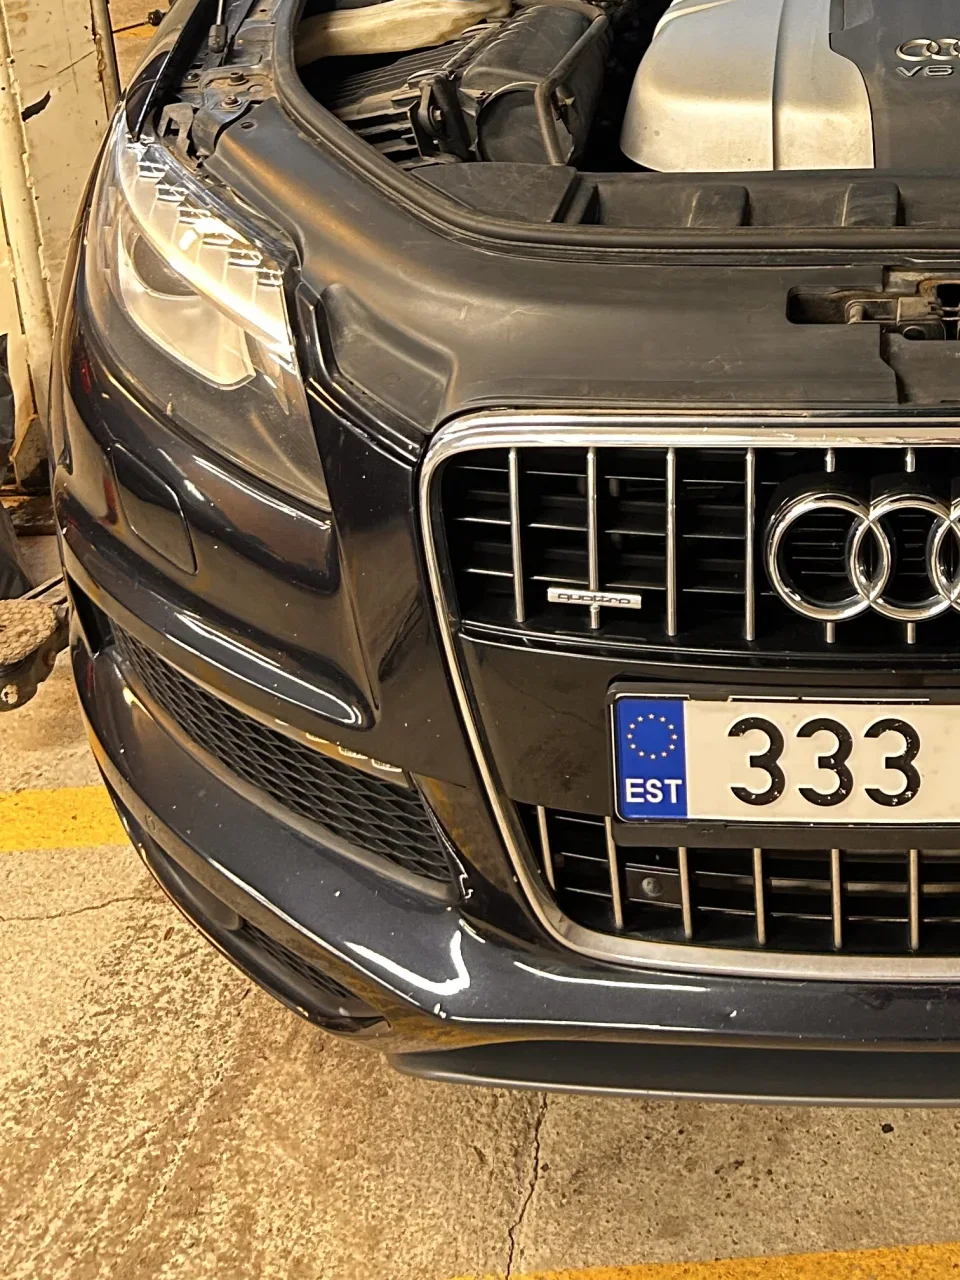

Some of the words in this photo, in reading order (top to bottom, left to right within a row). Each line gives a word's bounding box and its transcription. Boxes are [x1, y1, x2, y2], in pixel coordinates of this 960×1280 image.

[896, 64, 954, 78] V6
[557, 593, 631, 605] quattro
[727, 716, 922, 808] 333
[625, 778, 683, 804] EST
